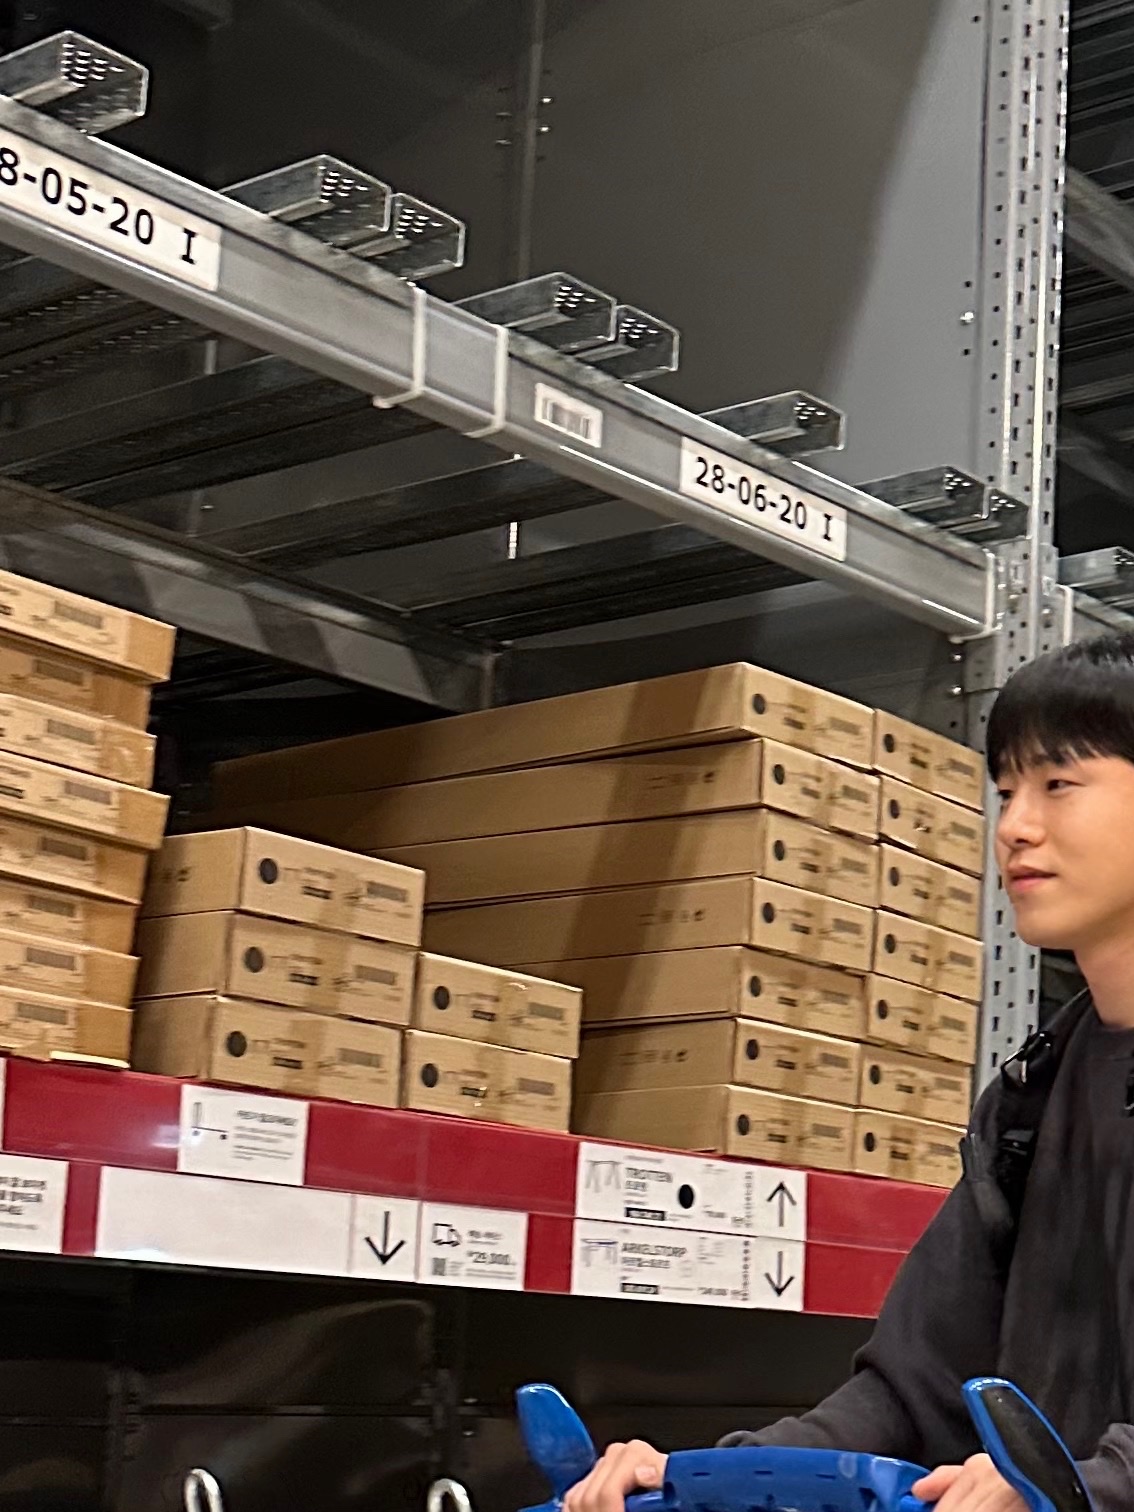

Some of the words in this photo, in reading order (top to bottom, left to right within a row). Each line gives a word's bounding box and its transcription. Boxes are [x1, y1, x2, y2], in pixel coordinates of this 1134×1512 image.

[180, 227, 198, 265] I
[695, 456, 807, 530] 28-06-20
[822, 513, 833, 541] I
